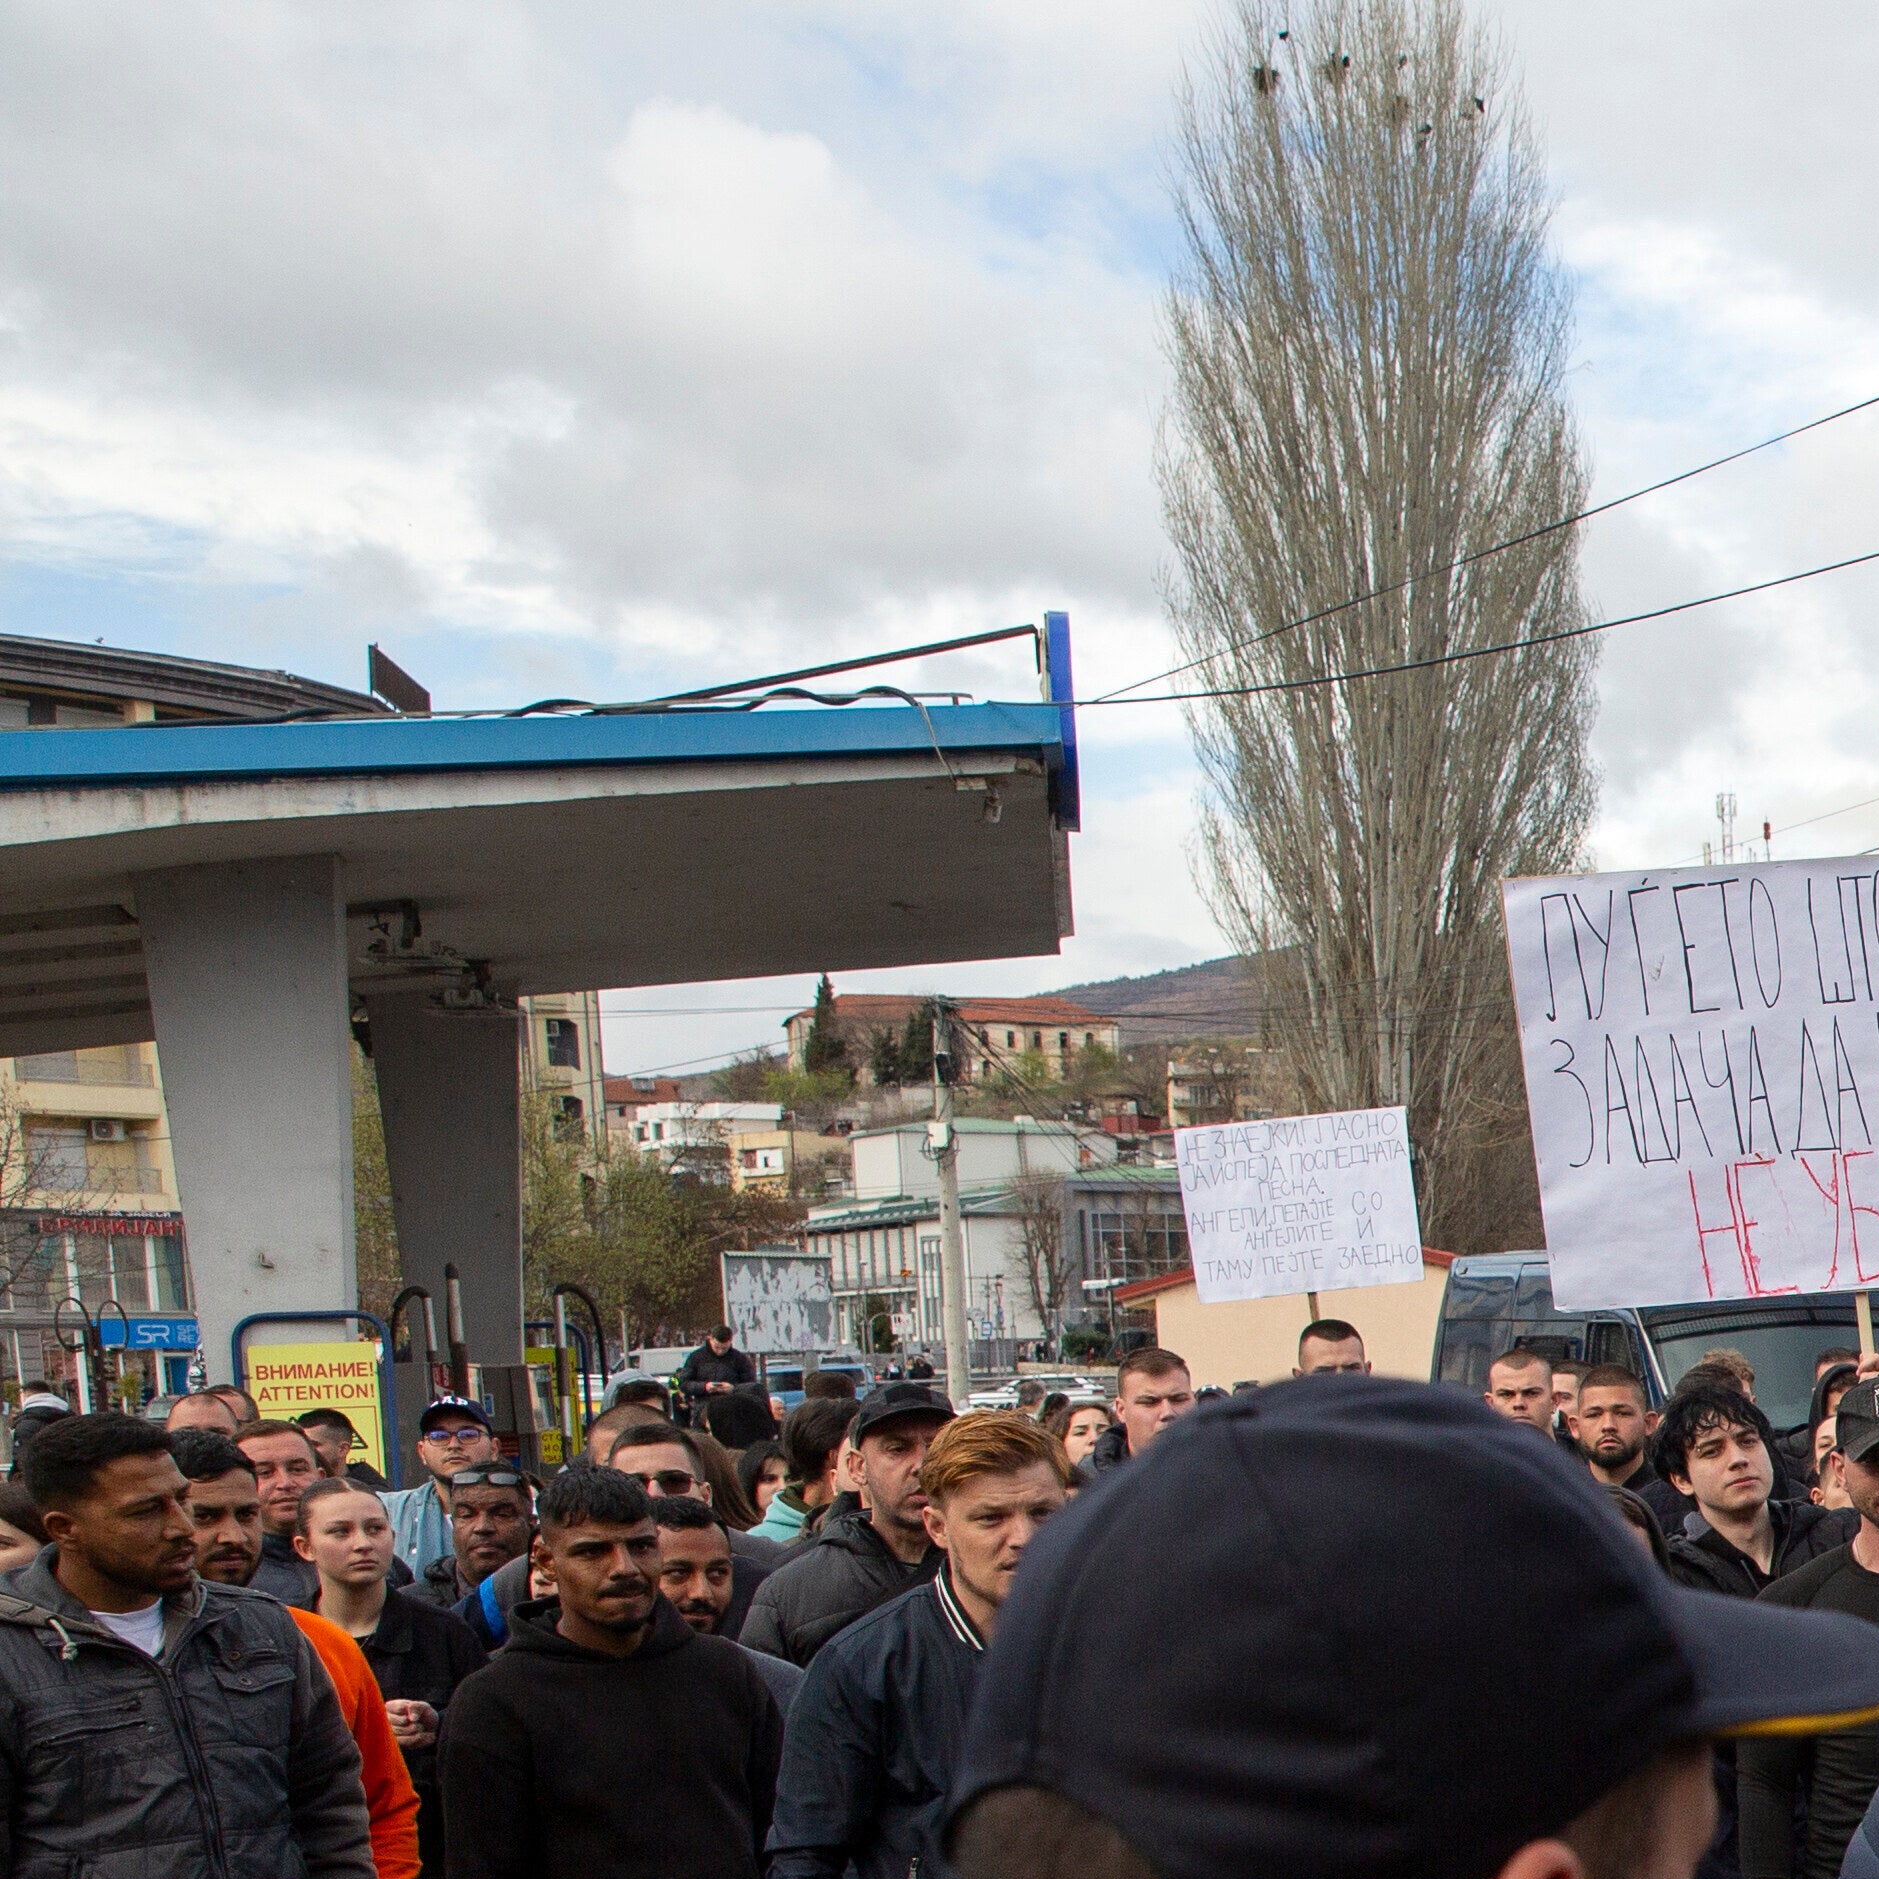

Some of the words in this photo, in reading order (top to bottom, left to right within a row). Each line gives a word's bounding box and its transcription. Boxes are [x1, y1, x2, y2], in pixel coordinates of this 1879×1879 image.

[1548, 1023, 1782, 1168] ЗАДАЧА
[1791, 1014, 1873, 1161] ДА
[1302, 1112, 1398, 1146] ГЛАСНО
[1290, 1139, 1407, 1174] ПОСЛЕДНАТА
[1351, 1191, 1382, 1216] СО
[1245, 1221, 1334, 1250] АНГЕЛИТЕ
[1356, 1216, 1374, 1239] И
[1202, 1256, 1253, 1283] ТАМУ
[1262, 1249, 1324, 1276] ПЕЈТЕ
[1338, 1243, 1418, 1269] ЗАЕДНО
[255, 1362, 374, 1381] ВНИМАНИЕ!
[258, 1383, 375, 1402] ATTENTION!
